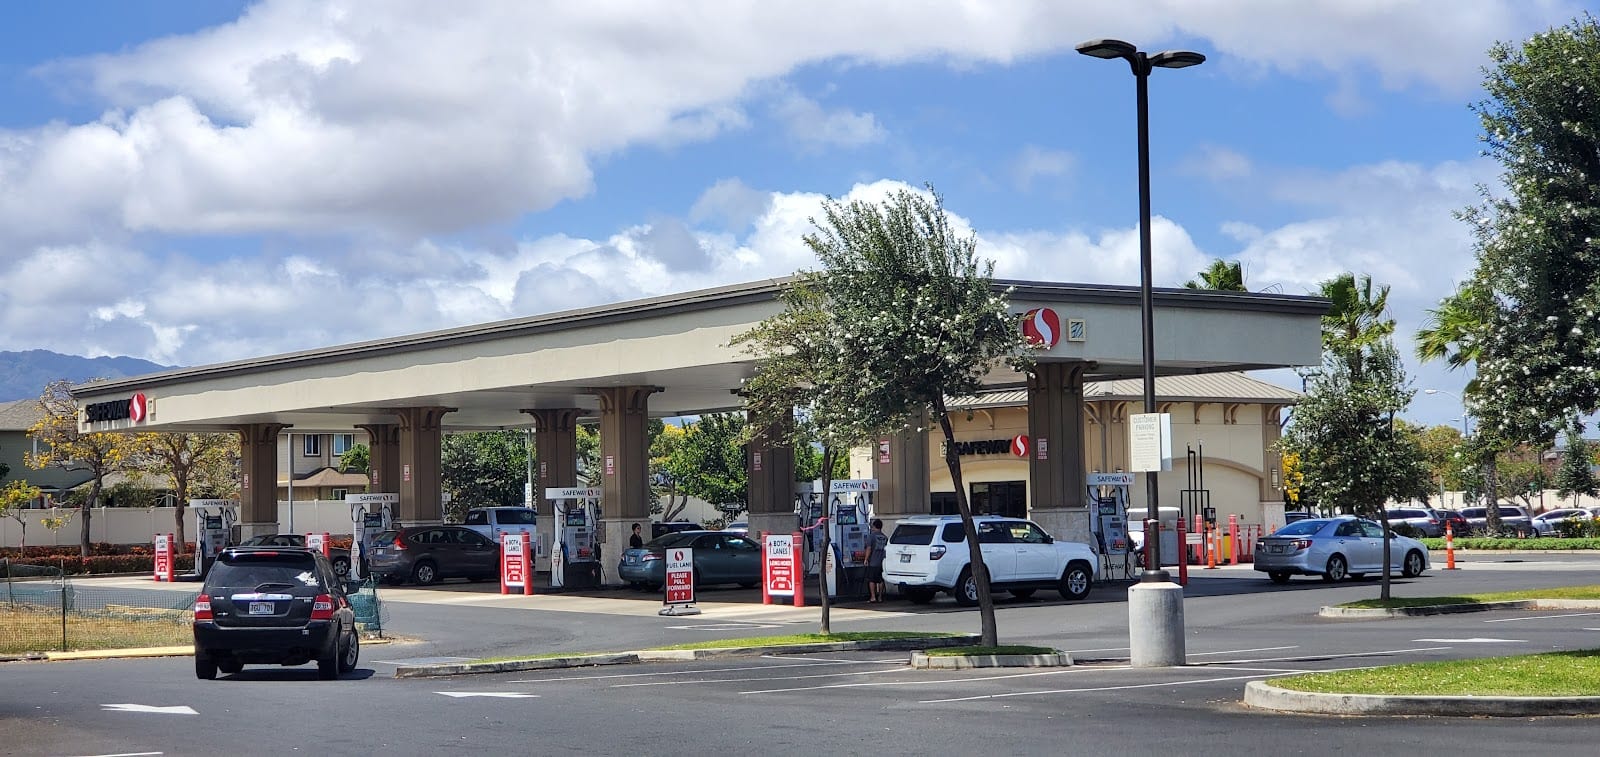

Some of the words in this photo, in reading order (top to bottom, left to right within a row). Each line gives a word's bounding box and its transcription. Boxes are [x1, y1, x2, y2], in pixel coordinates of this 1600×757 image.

[86, 399, 132, 422] SAFEWAY
[955, 440, 1012, 455] SAFEWAY
[834, 482, 861, 490] SAFEWAY
